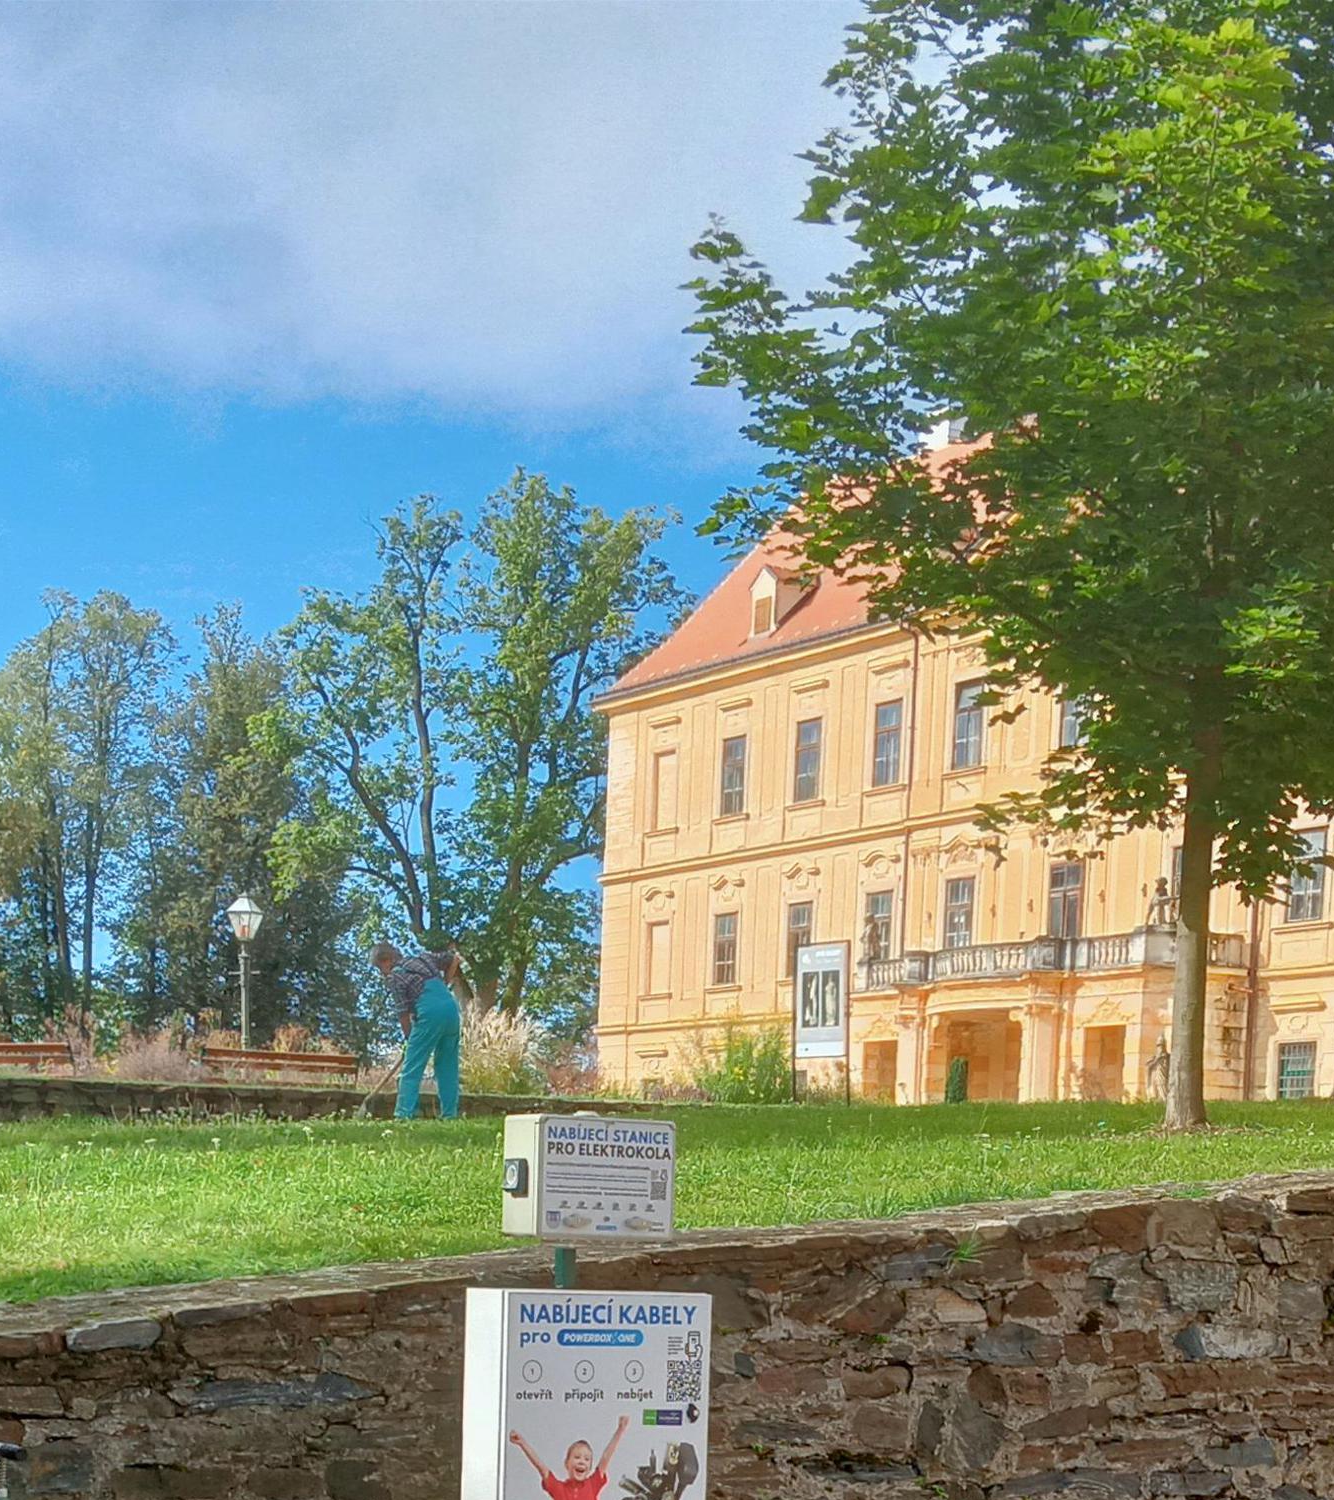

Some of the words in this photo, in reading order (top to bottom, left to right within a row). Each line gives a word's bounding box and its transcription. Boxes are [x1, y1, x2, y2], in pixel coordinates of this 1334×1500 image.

[547, 1124, 608, 1141] NABÍJECÍ
[613, 1129, 669, 1145] STANICE
[547, 1142, 575, 1155] PRO
[579, 1143, 671, 1160] ELEKTROKOLA
[520, 1298, 612, 1324] NABÍJECÍ
[619, 1306, 697, 1325] KABELY
[520, 1331, 551, 1348] pro
[617, 1334, 636, 1344] ONE
[516, 1389, 553, 1400] otevřít
[564, 1389, 604, 1403] připojit
[617, 1388, 653, 1402] nabíjet
